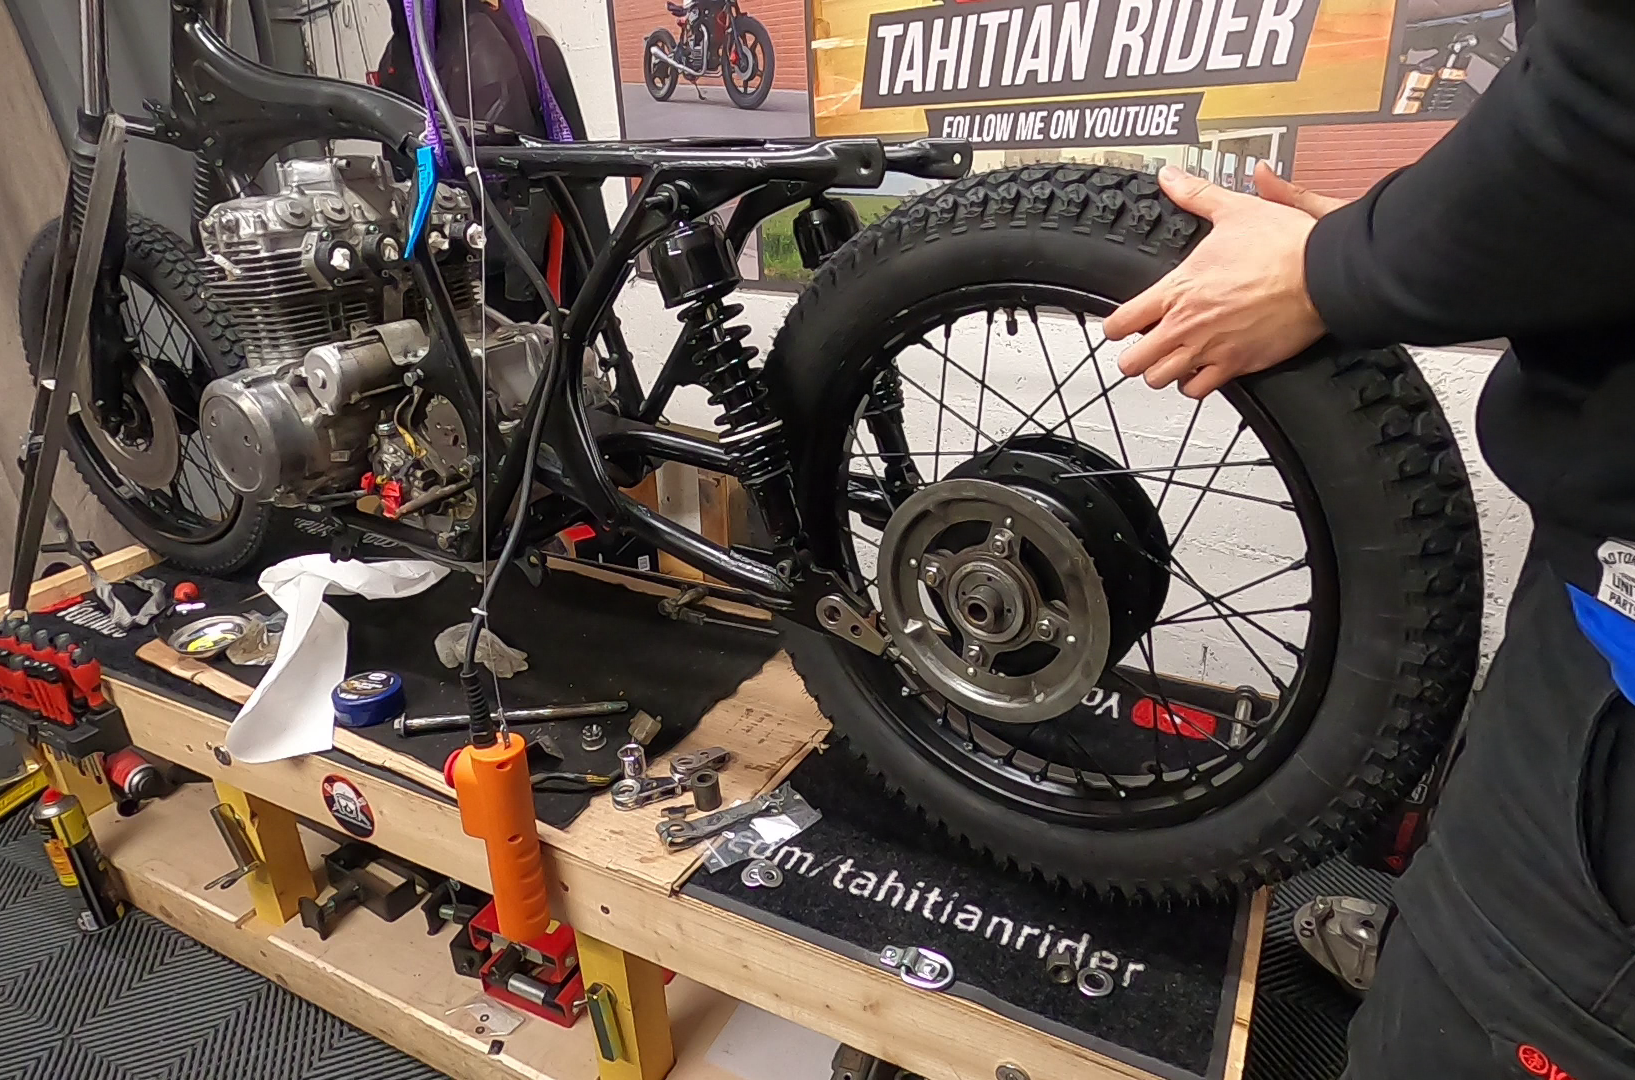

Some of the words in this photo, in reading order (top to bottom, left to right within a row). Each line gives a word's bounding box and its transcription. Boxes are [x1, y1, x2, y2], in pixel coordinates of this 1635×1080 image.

[877, 0, 1100, 96] TAHITIAN
[1104, 0, 1300, 79] RIDER
[942, 113, 1014, 143] FOLLOW
[1015, 111, 1047, 141] ME
[1049, 109, 1079, 139] ON
[1083, 103, 1184, 139] YOUTUBE
[1609, 591, 1635, 616] PART
